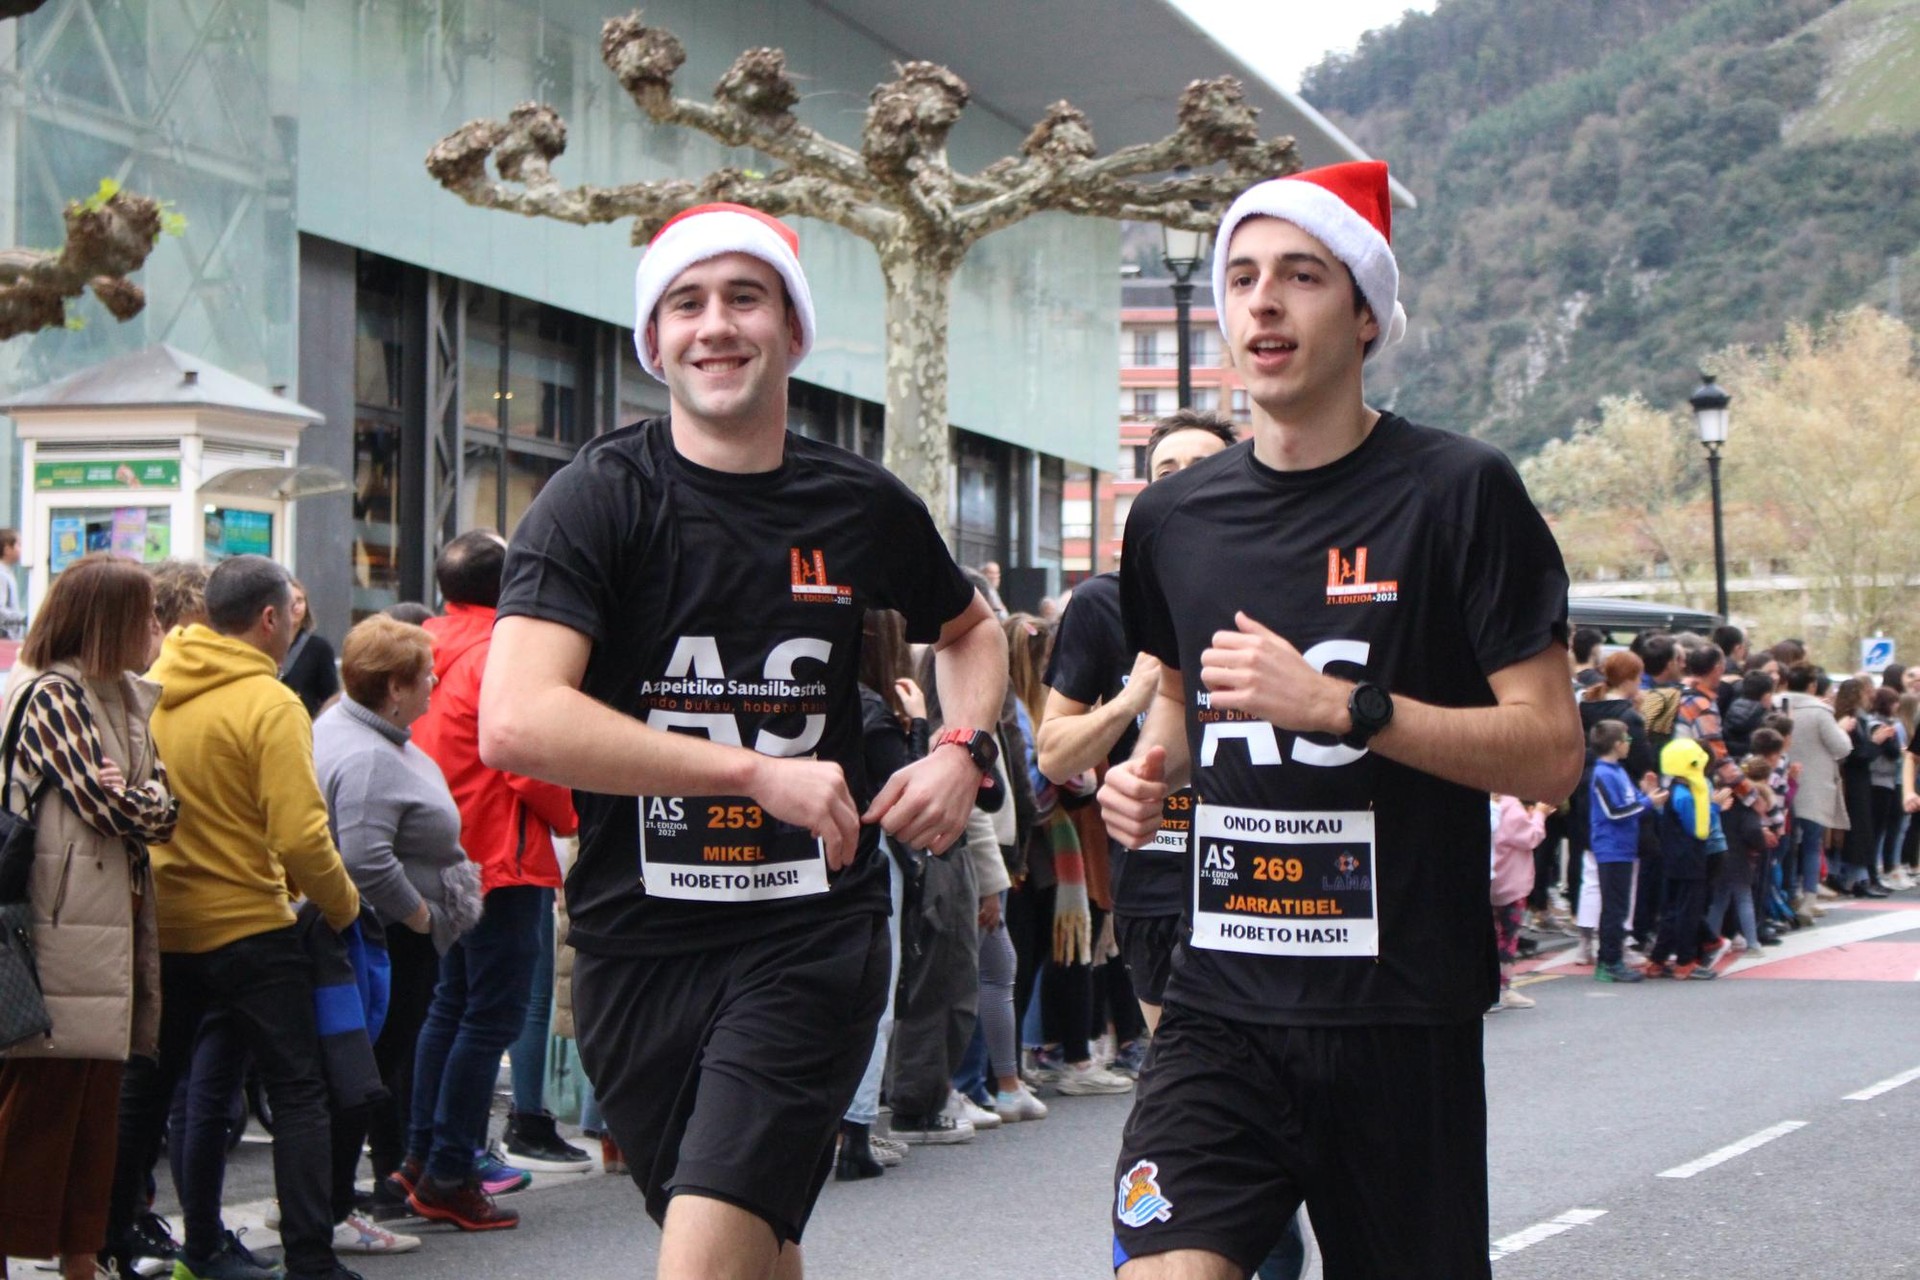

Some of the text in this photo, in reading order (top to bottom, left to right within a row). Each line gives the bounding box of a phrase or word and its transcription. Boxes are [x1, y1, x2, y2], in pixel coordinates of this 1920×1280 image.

[640, 678, 827, 697] Azpeitiko Sansilbestrie
[648, 797, 685, 822] AS
[706, 805, 763, 829] 253
[657, 822, 688, 831] EDIZIOA
[658, 829, 676, 837] 2022
[1223, 815, 1343, 834] ONDO BUKAU
[703, 846, 766, 862] MIKEL
[1204, 844, 1236, 871] AS
[1200, 870, 1239, 880] 21. EDIZIOA
[1252, 856, 1303, 882] 269
[670, 870, 799, 890] HOBETO HASI!
[1211, 878, 1229, 886] 2022
[1224, 895, 1343, 916] JARRATIBEL
[1220, 923, 1349, 943] HOBETO HASI!
